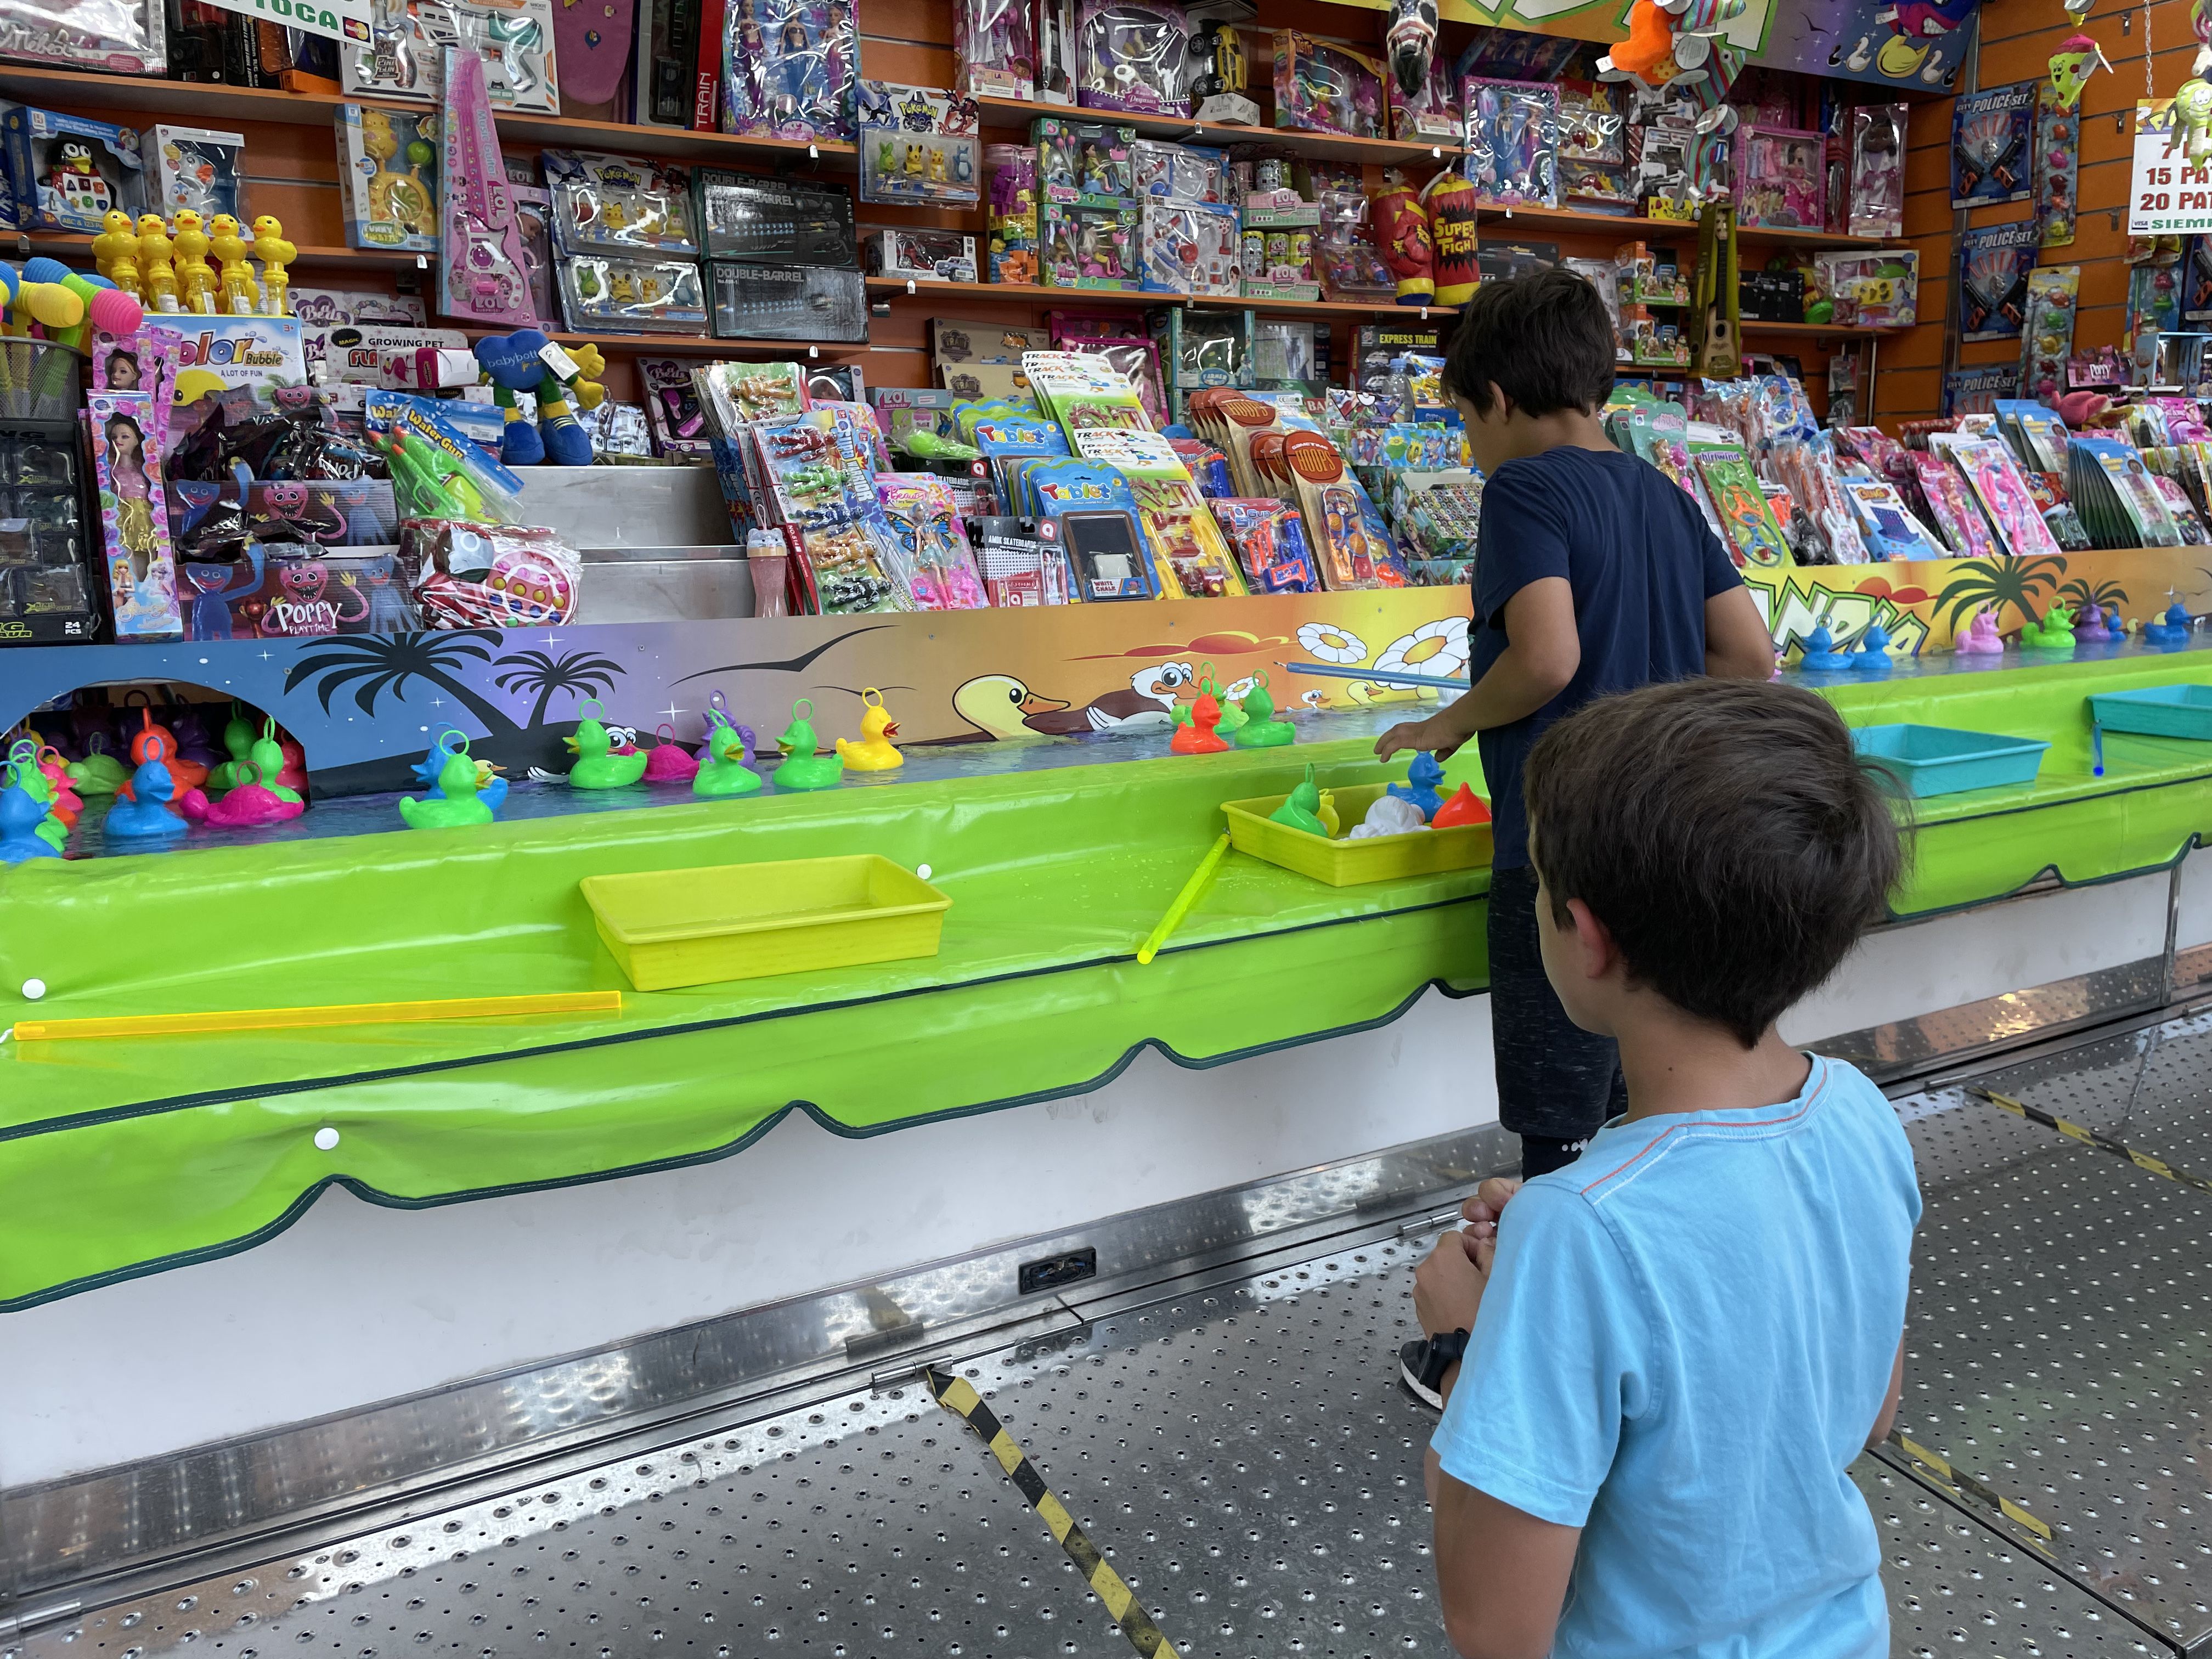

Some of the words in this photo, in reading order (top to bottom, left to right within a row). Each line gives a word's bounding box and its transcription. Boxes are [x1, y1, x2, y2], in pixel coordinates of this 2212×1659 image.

[696, 72, 711, 127] TRAIN
[1130, 95, 1156, 106] Pegasus
[1973, 94, 2011, 113] POLICE
[2012, 93, 2029, 106] SET
[477, 109, 490, 140] Music
[2146, 167, 2171, 185] 15
[2181, 166, 2212, 184] PA
[493, 187, 509, 218] LOL
[1276, 193, 1295, 202] LOL
[2140, 193, 2170, 211] 20
[62, 217, 75, 225] ABC
[1434, 217, 1475, 238] SUPER
[1437, 235, 1478, 256] FIGHT
[1979, 231, 2016, 248] POLICE
[2017, 230, 2032, 242] SET
[716, 268, 804, 283] DOUBLE-BARREL
[1276, 269, 1295, 278] LOL
[475, 297, 506, 308] LOL
[368, 338, 422, 347] GROWING
[1379, 334, 1413, 344] EXPRESS
[1415, 335, 1437, 345] TRAIN
[179, 331, 255, 367] olor
[246, 351, 283, 366] Bubble
[349, 348, 379, 368] FLA
[487, 349, 539, 368] babybott
[1041, 374, 1079, 382] TRACK
[1963, 375, 2000, 391] POLICE
[2001, 376, 2017, 387] SET
[884, 391, 912, 404] LOL
[1306, 400, 1325, 411] BA
[1226, 403, 1269, 417] HOOPS
[408, 409, 443, 441] Water
[439, 437, 465, 459] Gun
[977, 425, 1046, 443] Tablet
[1076, 431, 1116, 439] TRACK
[1086, 448, 1126, 456] TRACK
[1294, 448, 1336, 473] HOOPS
[887, 484, 927, 501] Beauty
[1040, 482, 1111, 500] Tablet
[1246, 509, 1271, 518] Gun
[989, 535, 1002, 544] AMOK
[1003, 537, 1036, 548] SKATEBOARDS
[275, 603, 342, 632] POPPY
[289, 623, 331, 635] PLAYTIME
